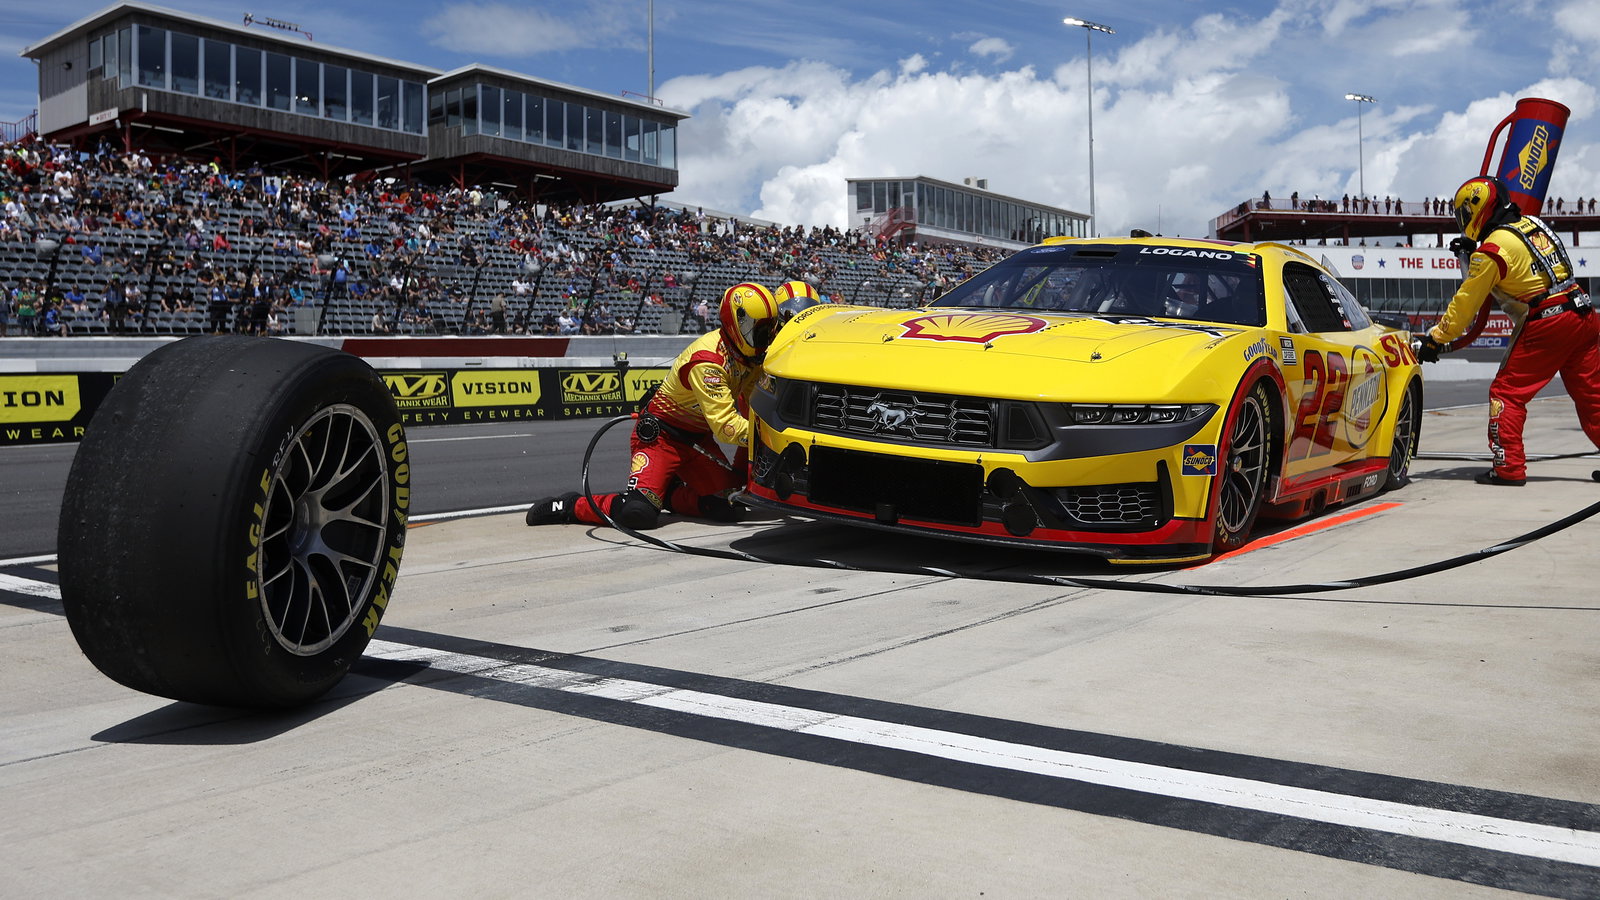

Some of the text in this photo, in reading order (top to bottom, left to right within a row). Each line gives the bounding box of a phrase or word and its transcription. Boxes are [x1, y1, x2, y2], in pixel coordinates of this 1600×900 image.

[1521, 126, 1548, 188] SUNOCO
[1139, 247, 1233, 260] LOGANO
[1399, 257, 1424, 269] THE
[1472, 337, 1501, 346] GEICO
[462, 381, 532, 395] VISION
[3, 390, 65, 407] ION
[422, 396, 448, 406] WEAR
[564, 391, 622, 402] MECHANIX WEAR
[564, 406, 623, 416] SAFETY
[1289, 349, 1348, 462] 22
[402, 412, 449, 423] FETY
[464, 409, 544, 420] EYEWEAR
[6, 426, 85, 440] WEAR
[1185, 456, 1213, 465] SUNOCO
[1363, 474, 1378, 488] FORD
[246, 468, 272, 600] EAGLE
